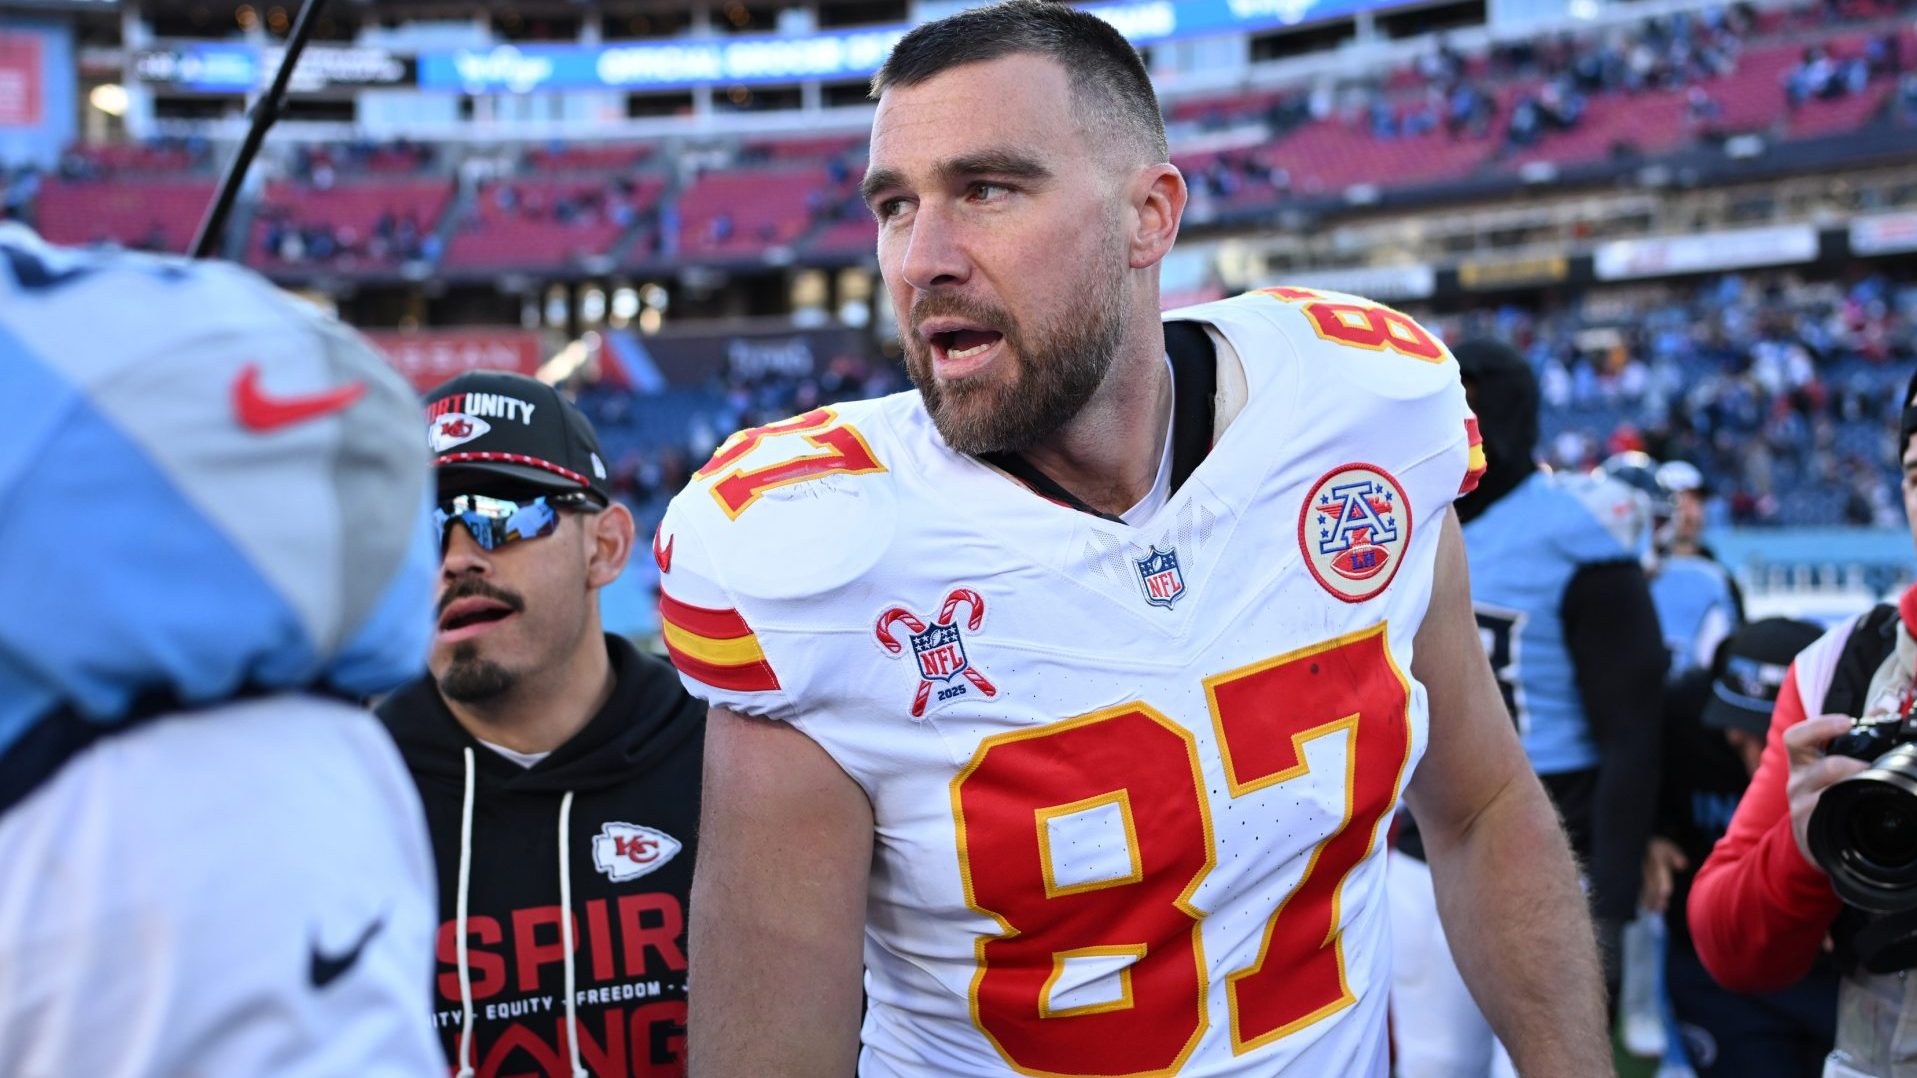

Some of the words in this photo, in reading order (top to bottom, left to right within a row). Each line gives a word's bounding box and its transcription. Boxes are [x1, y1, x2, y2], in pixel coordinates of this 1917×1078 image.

[1319, 481, 1397, 554] A
[1351, 551, 1376, 570] LH
[1146, 571, 1182, 598] NFL
[919, 645, 964, 676] NFL
[938, 684, 967, 701] 2025
[614, 835, 660, 864] KC
[949, 619, 1412, 1077] 87
[435, 892, 689, 1001] SPIR
[486, 996, 553, 1020] EQUITY
[576, 981, 661, 1005] FREEDOM
